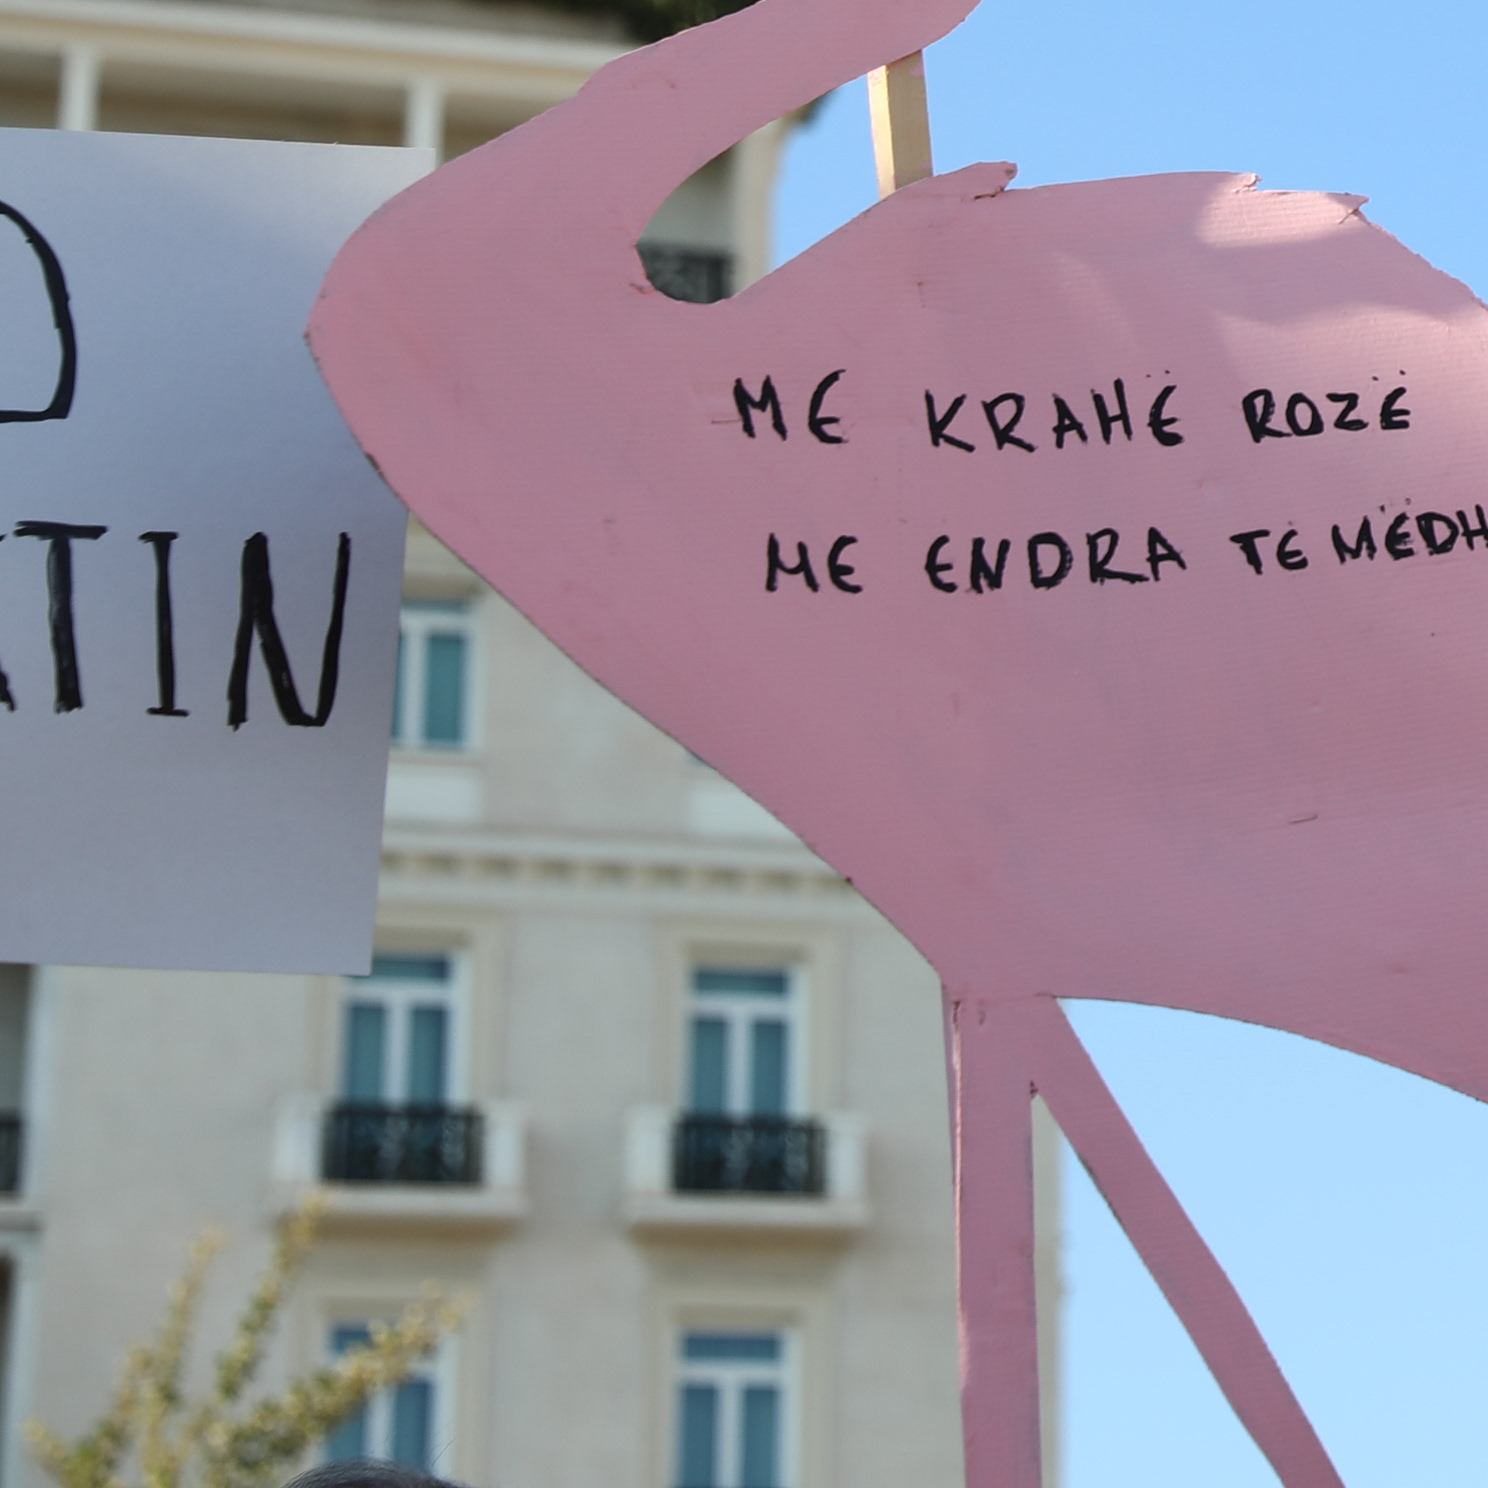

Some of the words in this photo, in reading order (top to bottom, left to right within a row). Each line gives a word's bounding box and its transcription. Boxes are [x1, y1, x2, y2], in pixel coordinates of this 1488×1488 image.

[734, 370, 845, 444] ME
[1242, 371, 1410, 443] ROZË
[766, 534, 862, 593] ME
[925, 528, 1186, 593] ENDRA
[0, 521, 350, 730] TIN
